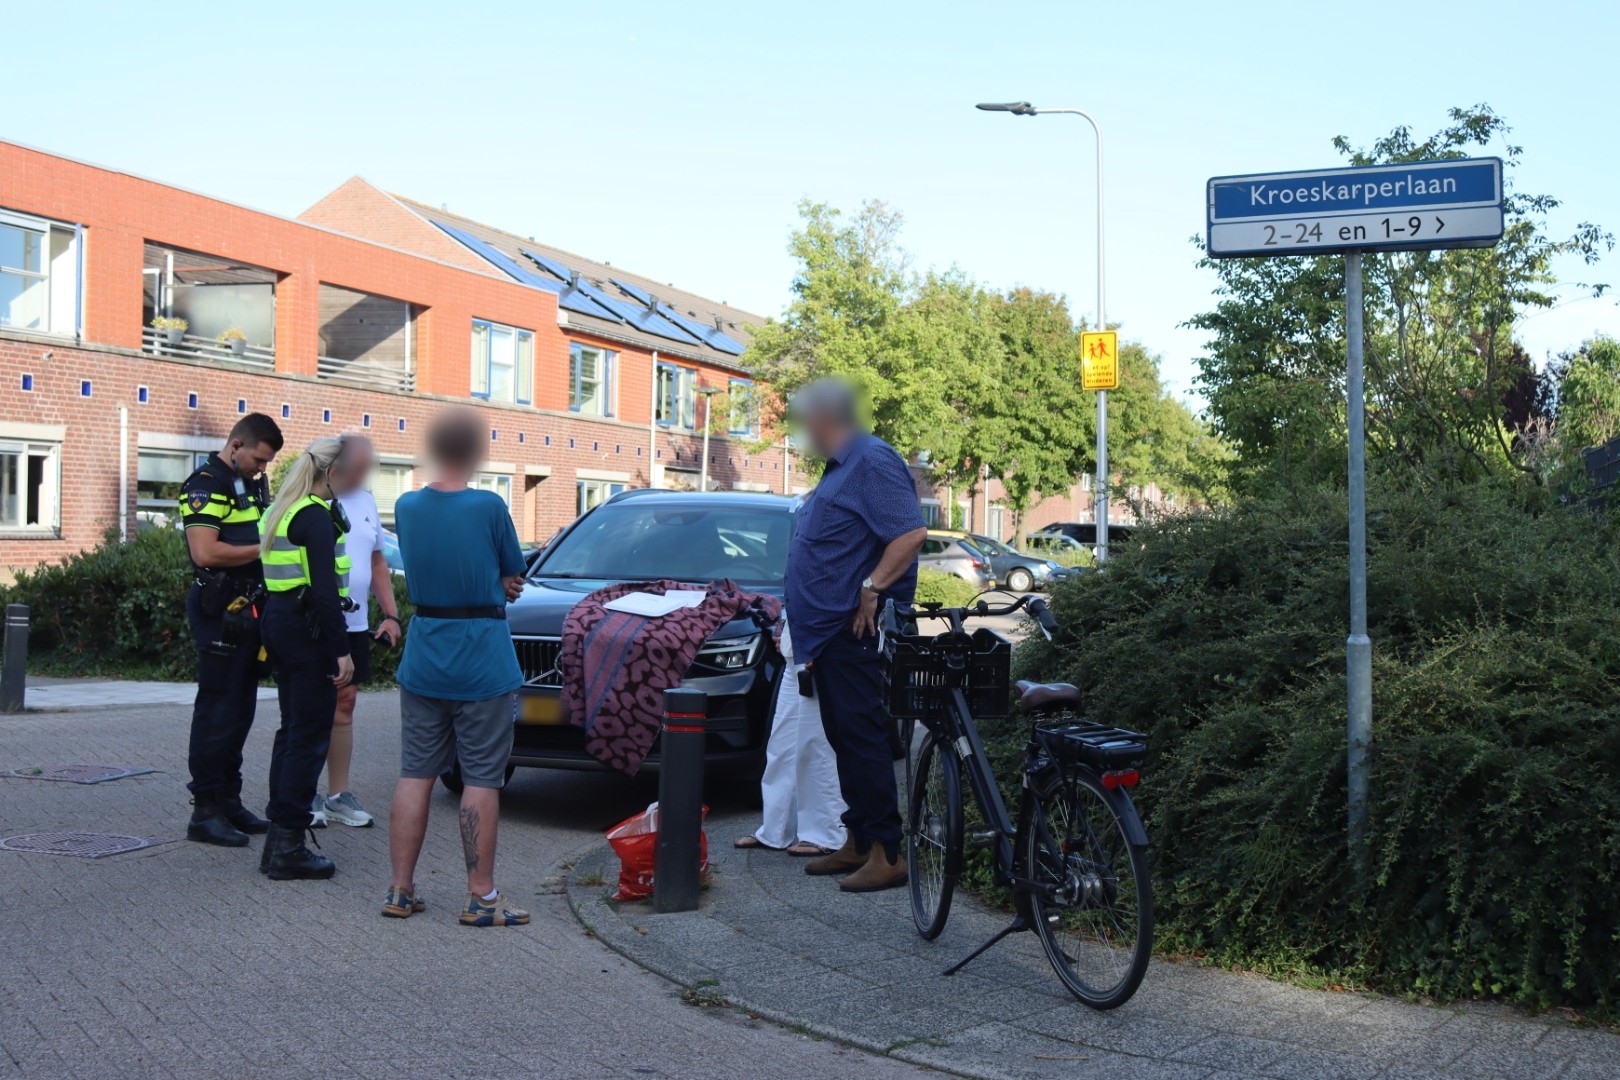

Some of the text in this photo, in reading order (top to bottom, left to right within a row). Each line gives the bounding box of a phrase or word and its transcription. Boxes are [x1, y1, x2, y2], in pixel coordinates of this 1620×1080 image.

[1250, 175, 1457, 206] Kroeskarperlaan
[1264, 215, 1422, 246] 2-24 en 1-9
